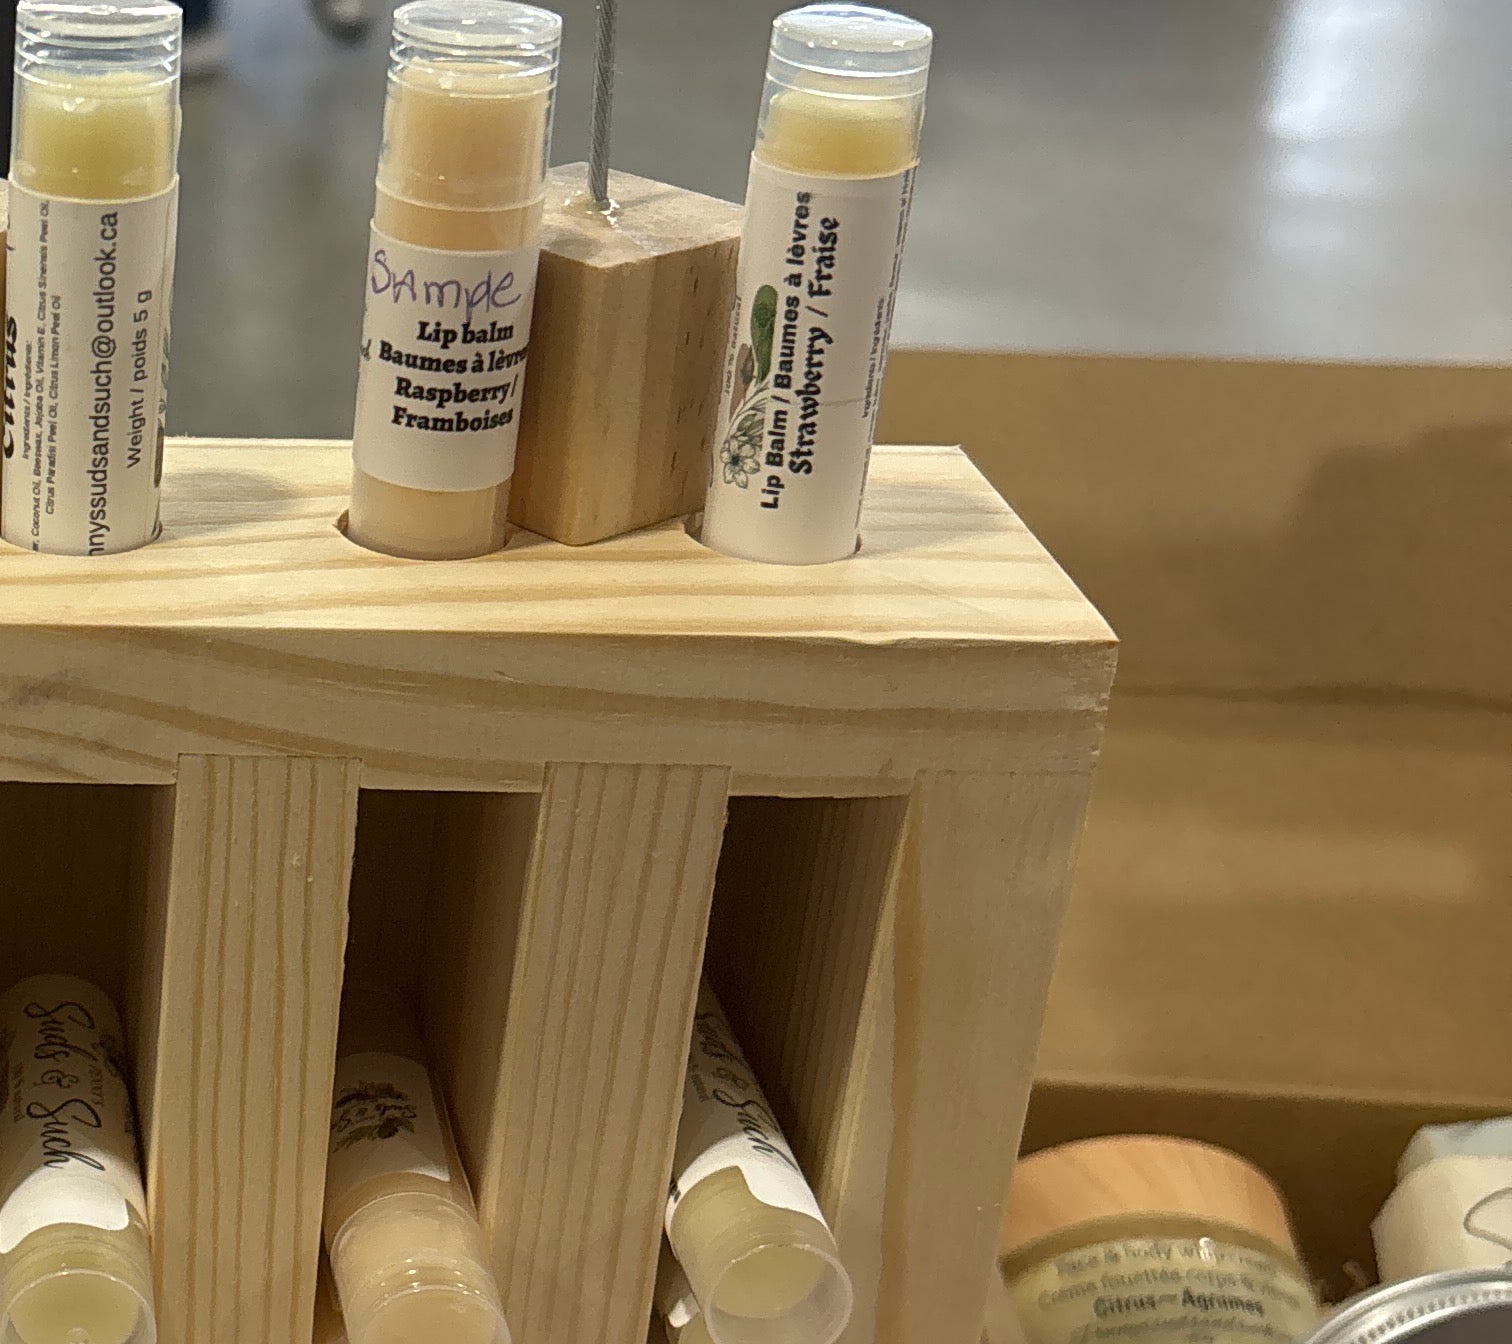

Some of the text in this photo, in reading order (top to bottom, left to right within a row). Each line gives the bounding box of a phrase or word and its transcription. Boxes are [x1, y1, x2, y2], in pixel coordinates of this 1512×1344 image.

[37, 291, 46, 321] Citrus
[51, 295, 61, 310] Oil
[136, 290, 152, 303] g
[50, 313, 60, 335] Peel
[133, 310, 148, 322] 5
[417, 320, 513, 349] Lip balm
[760, 191, 811, 509] Lip Balm / Baumes à lèvres
[787, 217, 840, 475] Strawberry / Fraise
[36, 337, 45, 374] Vitamin
[49, 337, 59, 368] Limon
[131, 328, 148, 381] poids
[379, 339, 468, 374] Baumes
[471, 352, 484, 373] à
[49, 371, 59, 399] Citrus
[395, 376, 510, 408] Raspberry
[47, 421, 57, 443] Peel
[126, 398, 146, 468] Weight
[392, 405, 513, 432] Framboises
[46, 487, 55, 514] Citrus
[31, 497, 41, 536] Coconut
[24, 1000, 98, 1061] Suds
[26, 1099, 106, 1171] Such
[1093, 1293, 1156, 1318] Citrus
[1182, 1287, 1264, 1317] Agrumes
